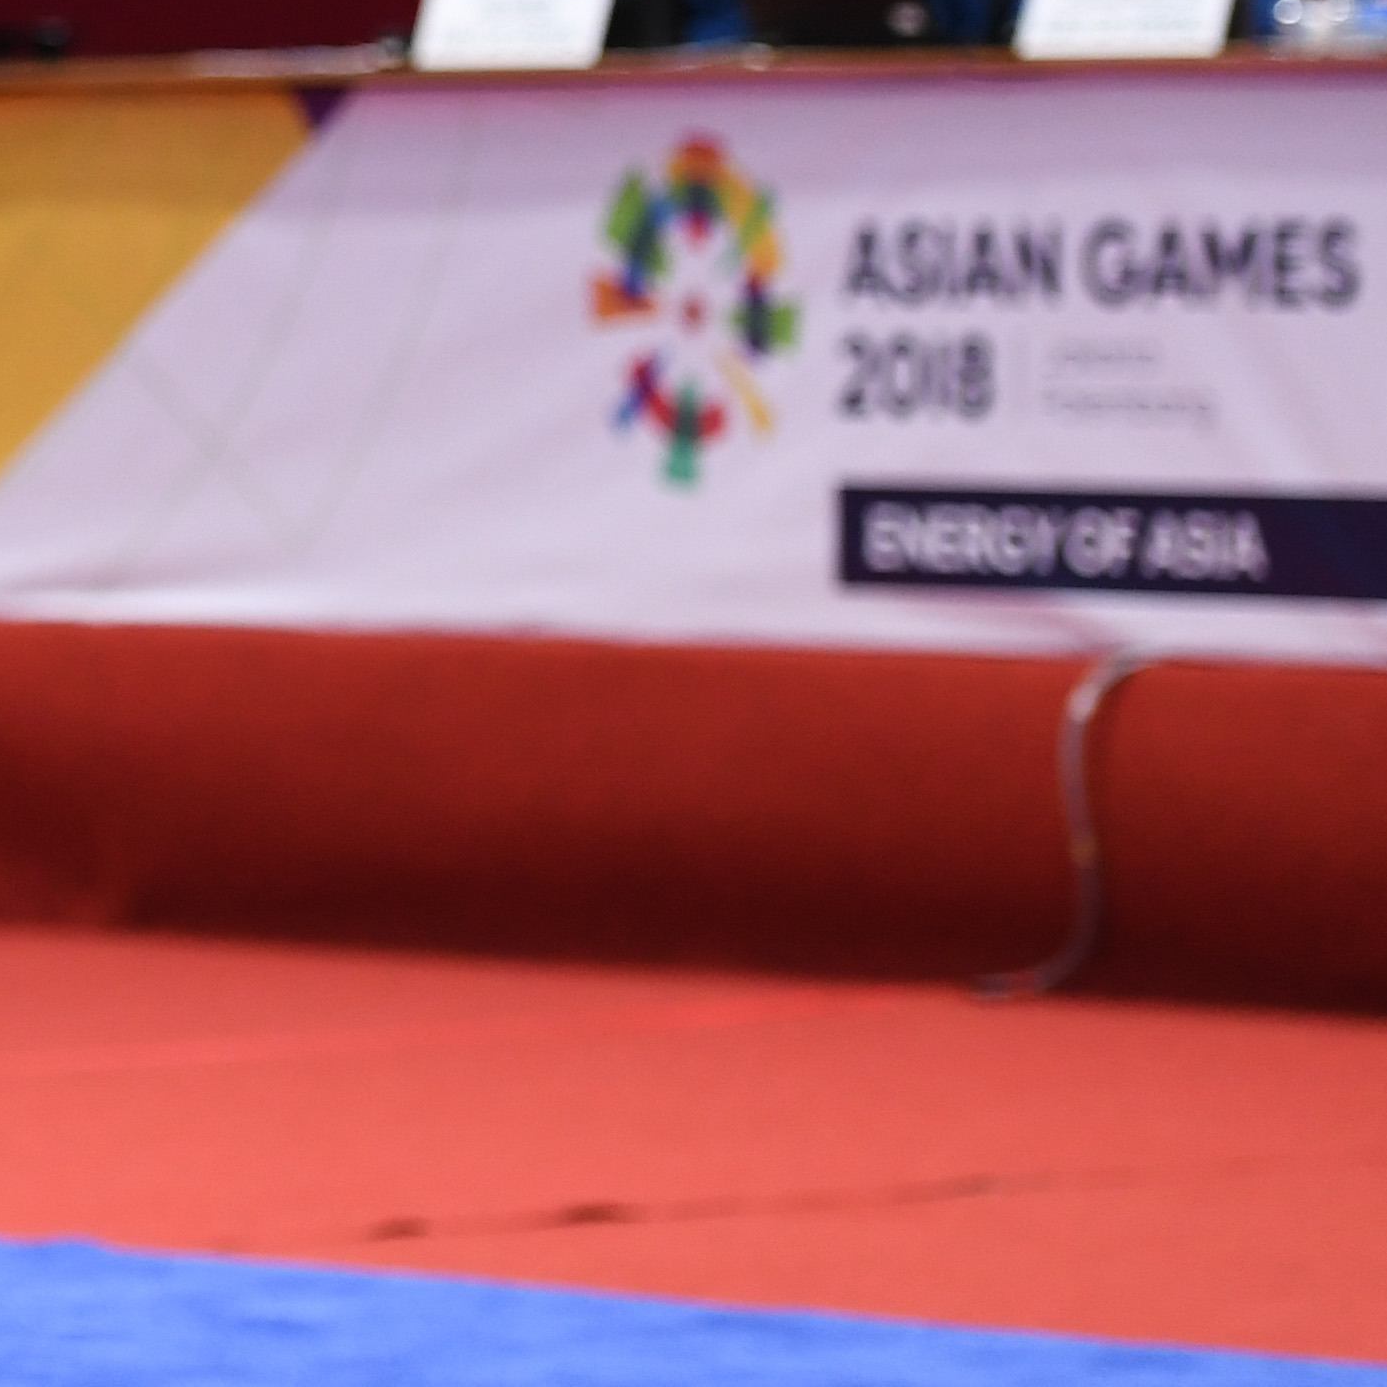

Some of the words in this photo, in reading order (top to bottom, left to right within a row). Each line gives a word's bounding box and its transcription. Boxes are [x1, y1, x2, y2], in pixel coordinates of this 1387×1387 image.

[840, 214, 1064, 306] ASIAN
[1080, 212, 1364, 312] GAMES
[836, 330, 996, 422] 2018
[858, 498, 1056, 578] ENERGY
[1060, 505, 1142, 580] OF
[1140, 509, 1274, 584] ASIA
